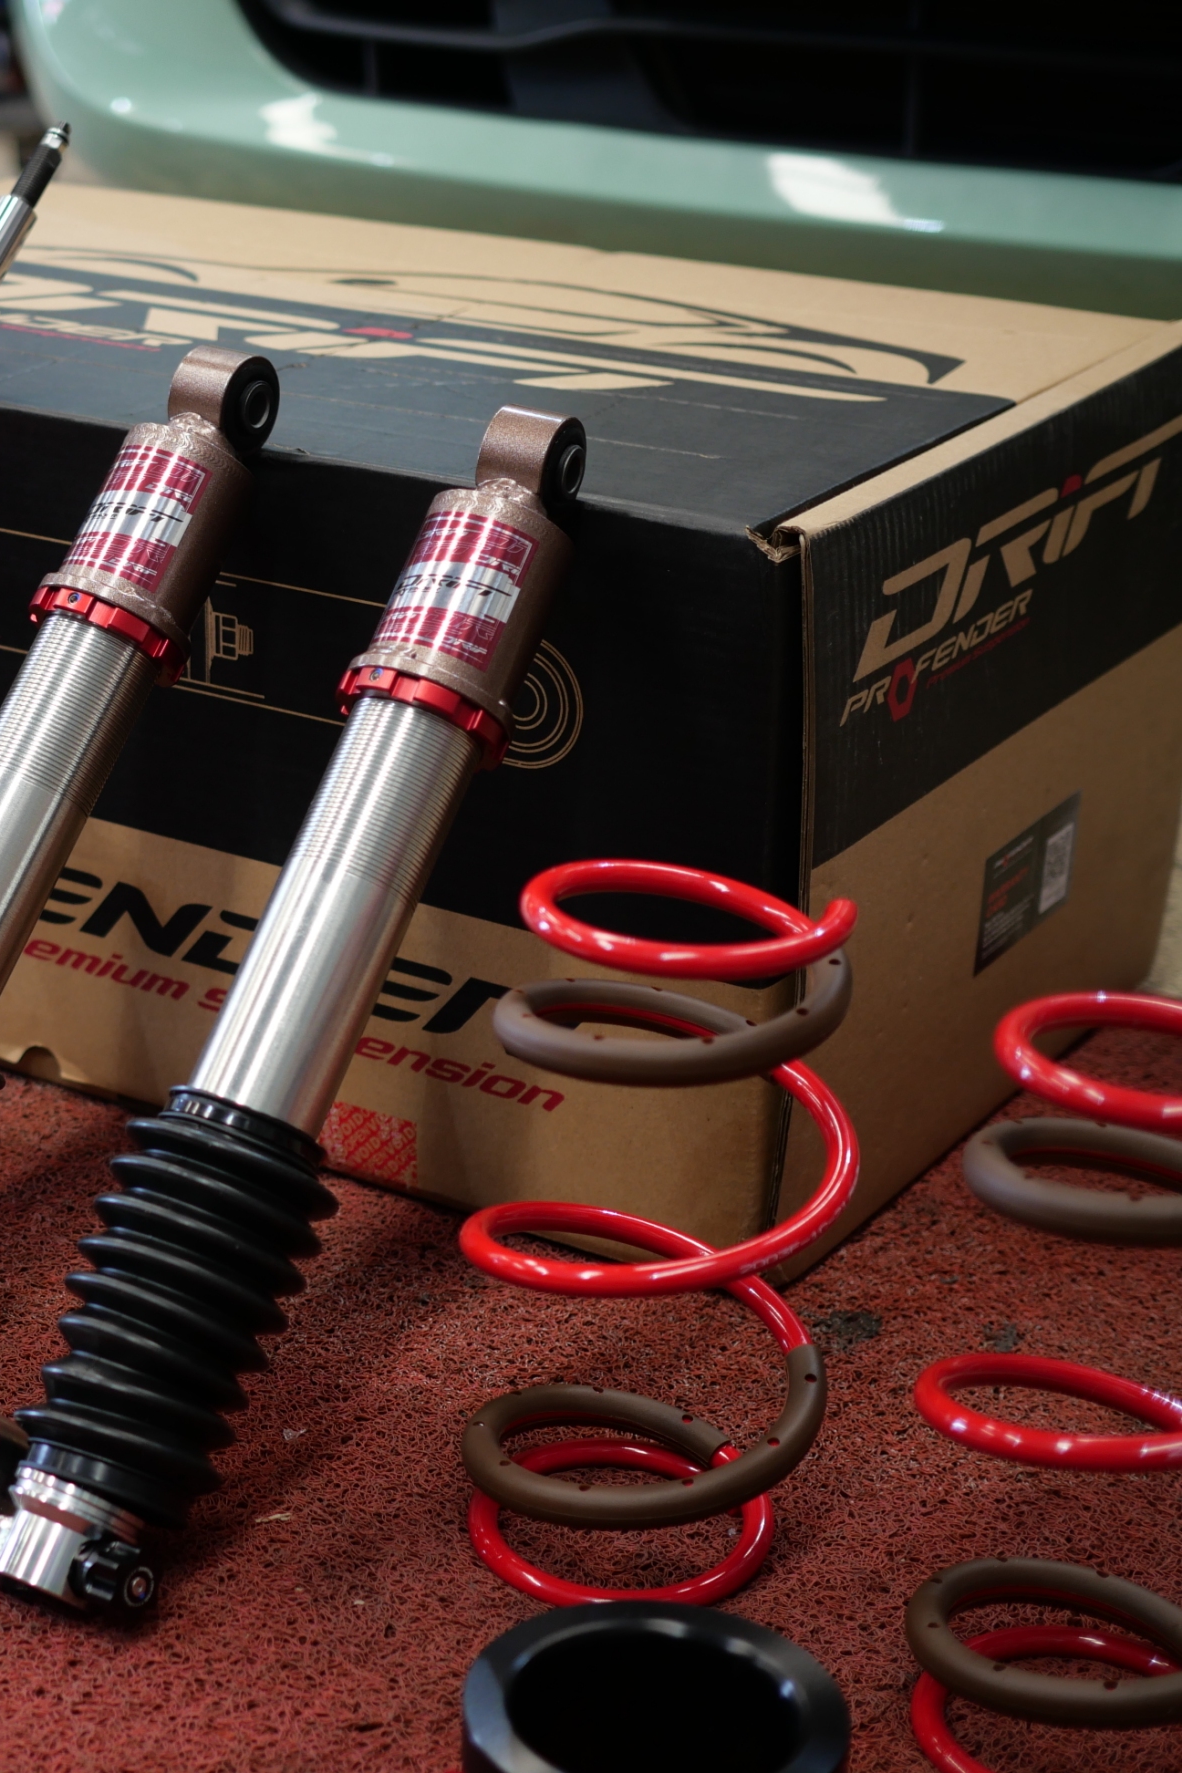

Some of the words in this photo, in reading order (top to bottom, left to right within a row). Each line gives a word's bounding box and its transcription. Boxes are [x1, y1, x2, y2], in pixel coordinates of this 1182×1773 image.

[839, 588, 1034, 728] PROFENDER
[21, 937, 191, 1002] emium
[198, 987, 565, 1113] sension
